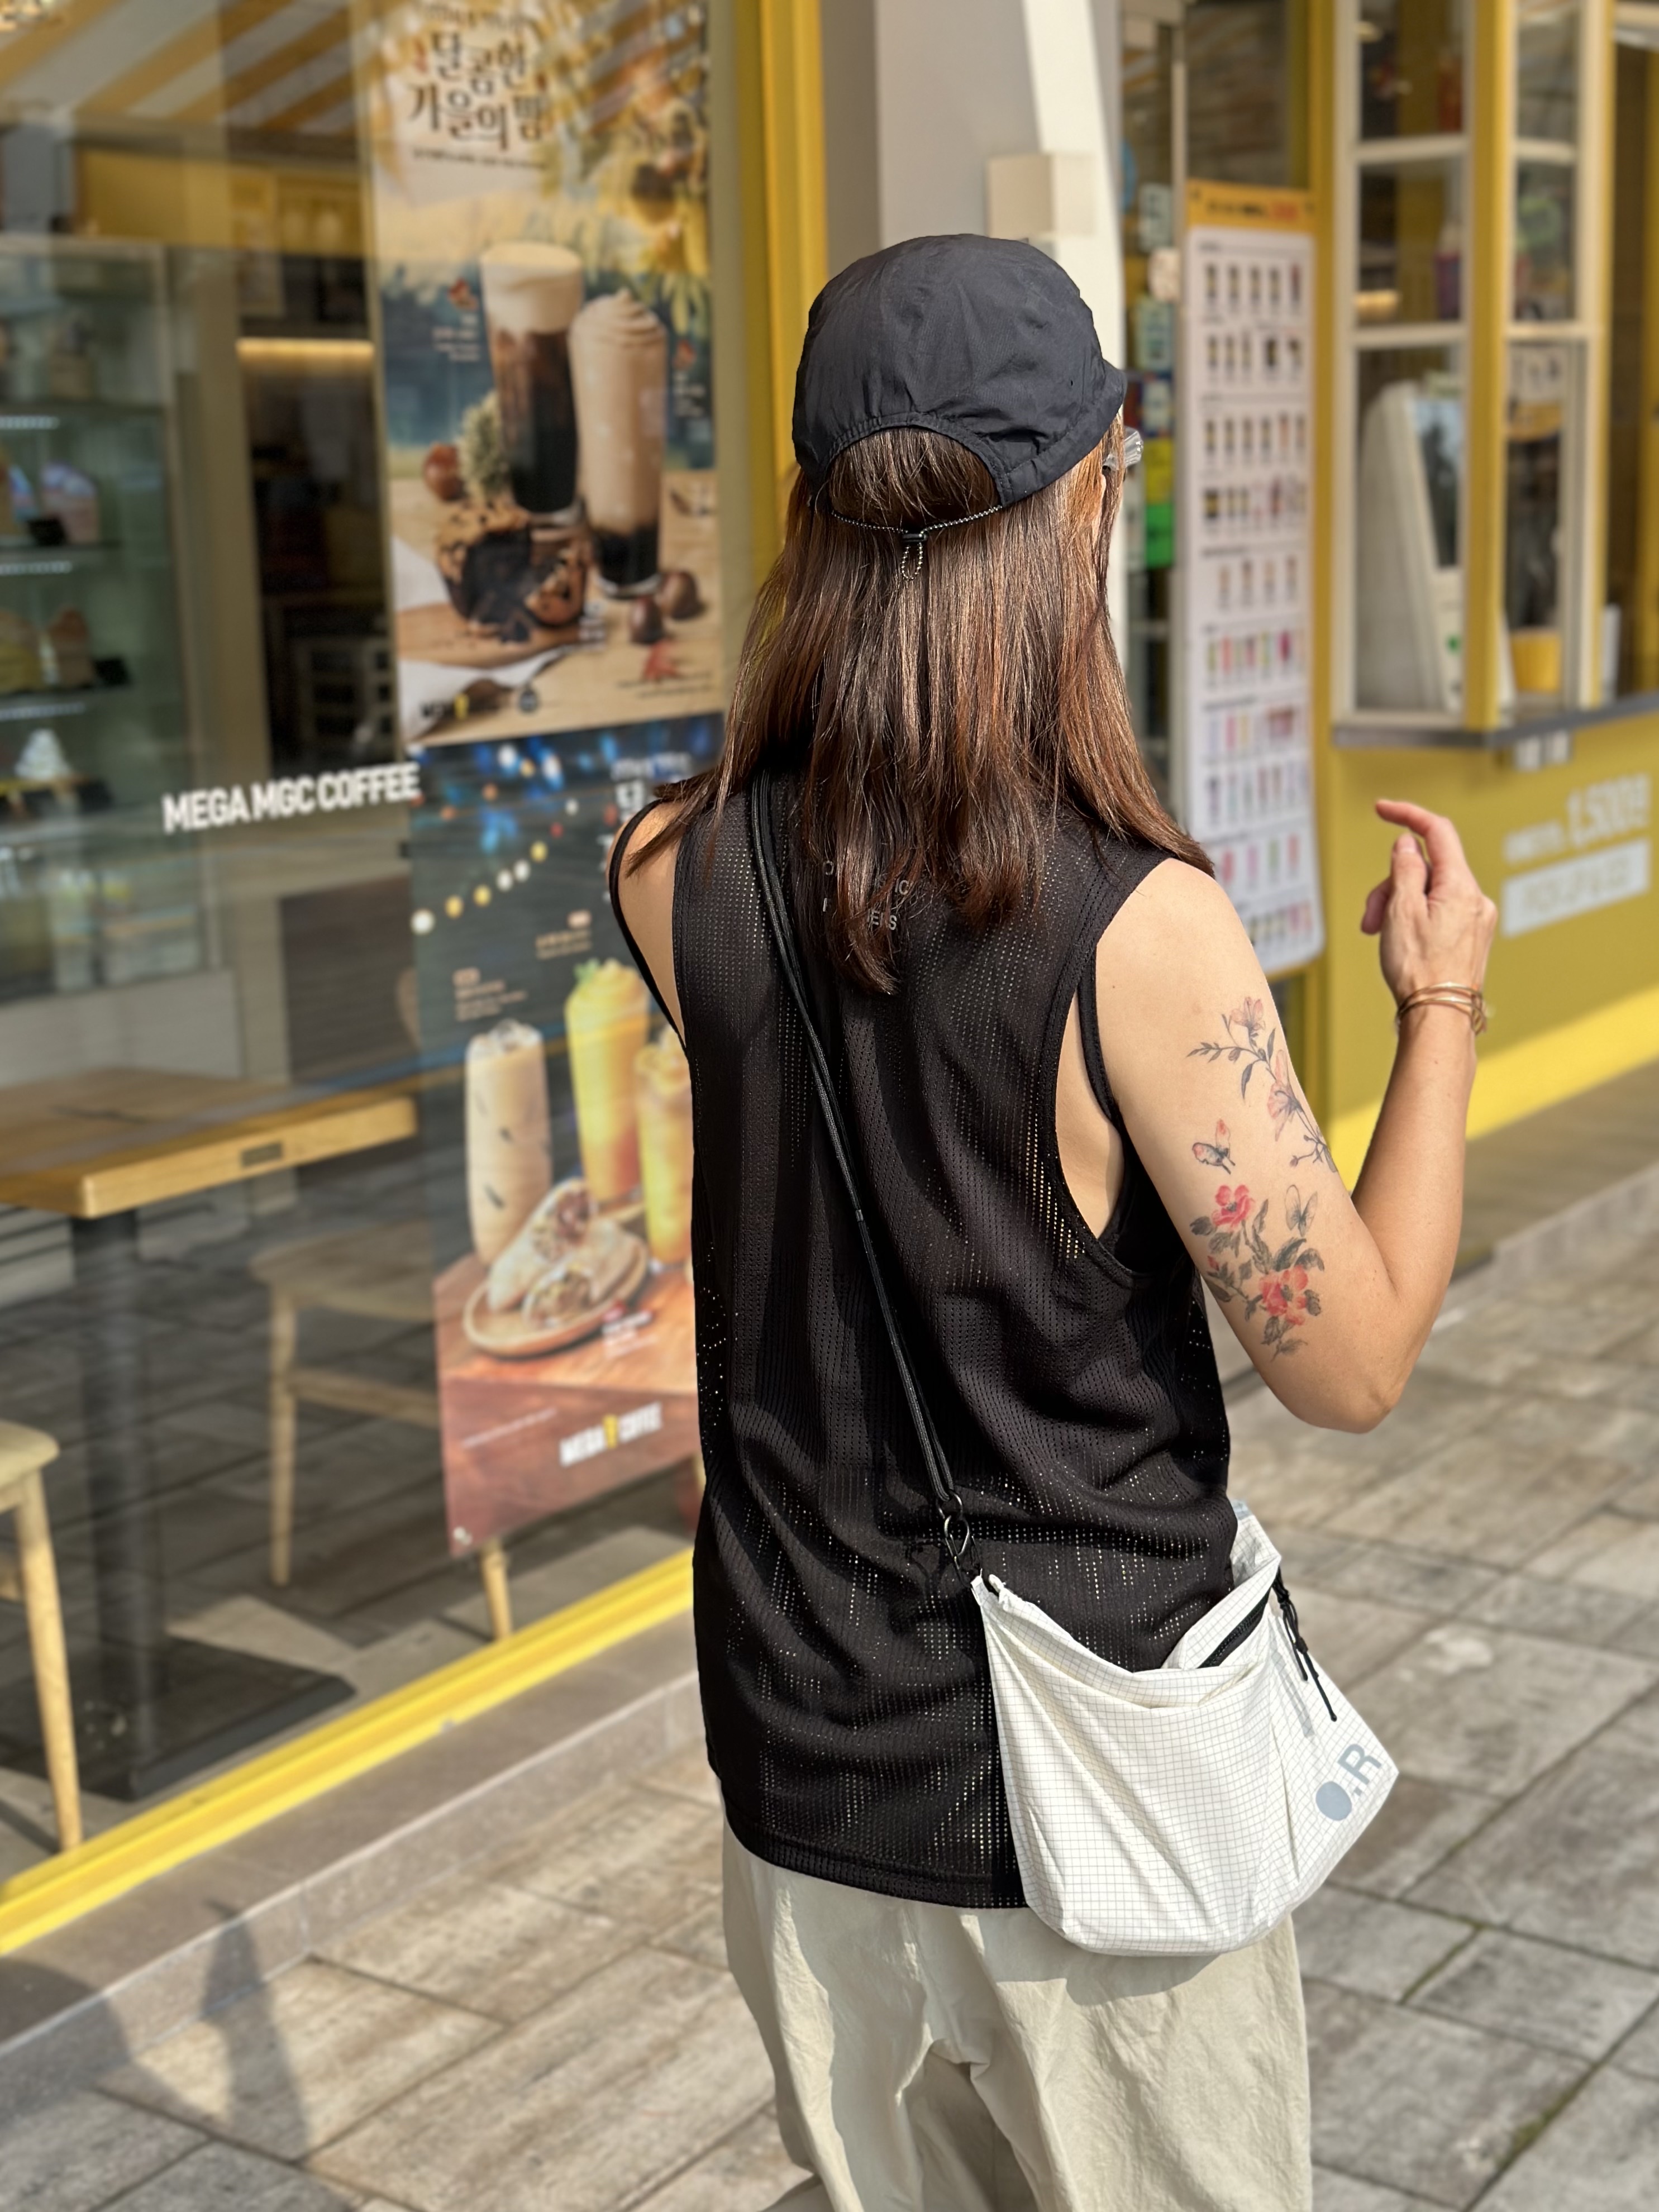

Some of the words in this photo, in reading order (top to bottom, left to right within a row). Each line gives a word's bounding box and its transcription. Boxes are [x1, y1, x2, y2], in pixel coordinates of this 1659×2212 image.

[408, 83, 509, 151] 가을의
[162, 785, 251, 834] MEGA
[251, 775, 316, 821] MGC
[317, 761, 422, 810] COFFEE
